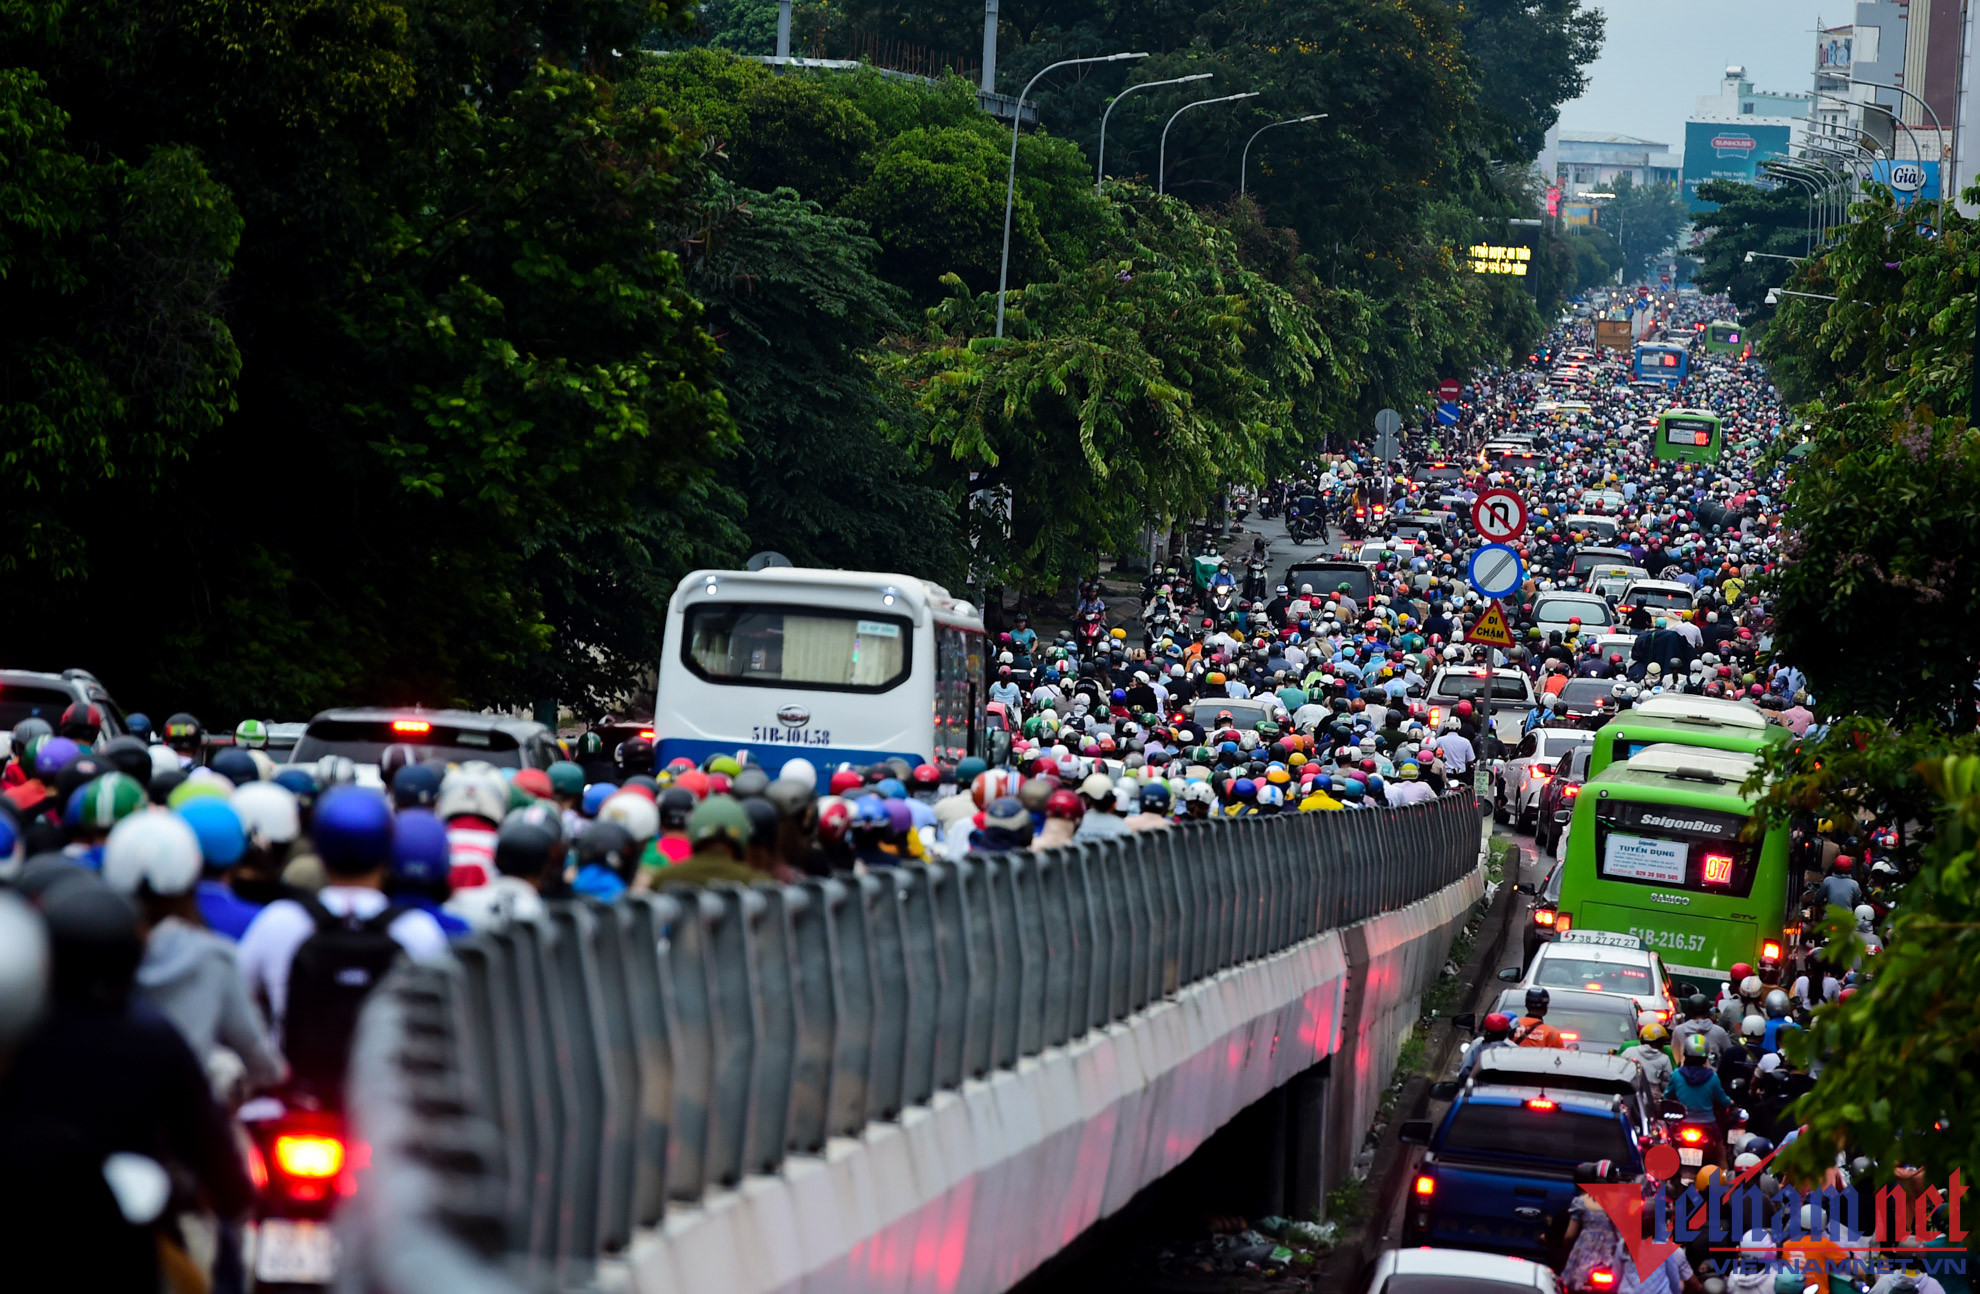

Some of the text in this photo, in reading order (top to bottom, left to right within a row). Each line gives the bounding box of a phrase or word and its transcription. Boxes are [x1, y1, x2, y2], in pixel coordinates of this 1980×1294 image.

[1488, 616, 1498, 625] ĐI
[1477, 627, 1504, 639] CHẬM
[1640, 813, 1723, 834] SaigonBus
[1706, 857, 1732, 882] 07
[1651, 891, 1690, 906] SAMCO
